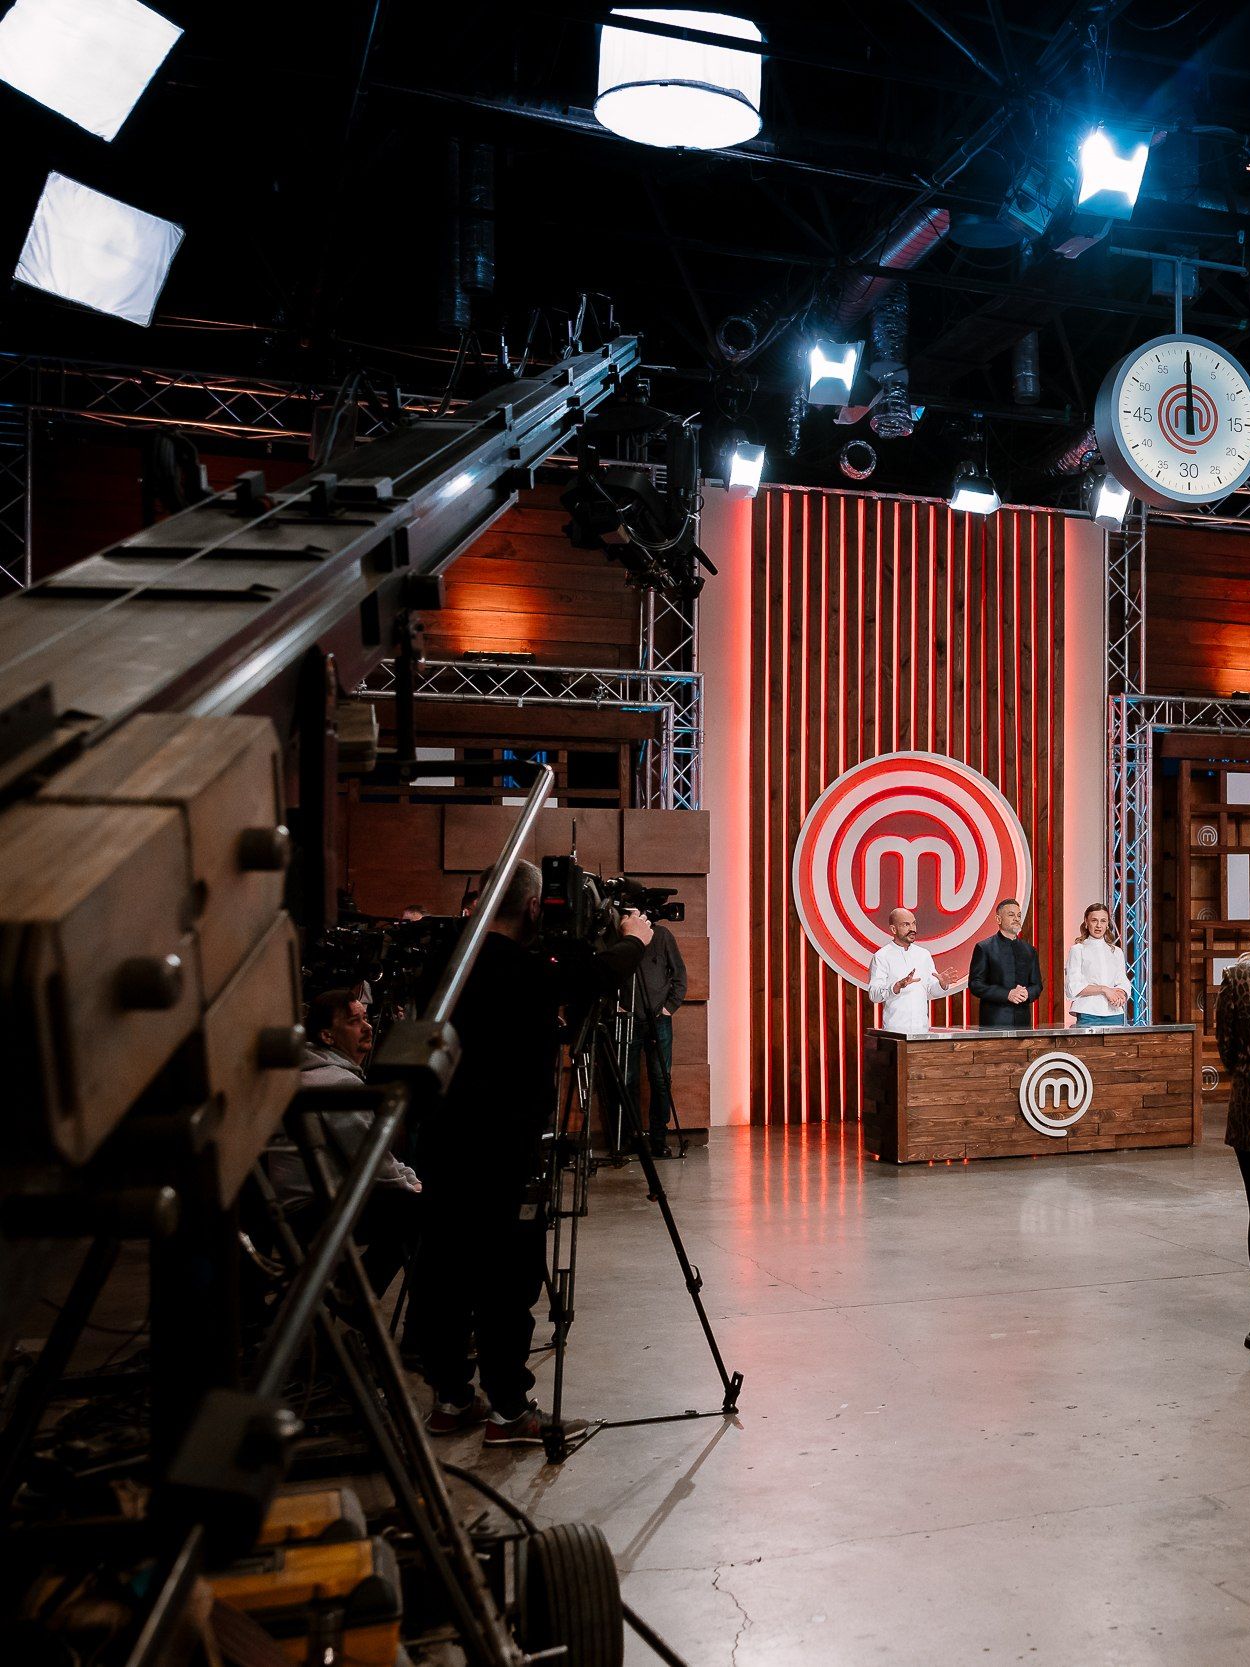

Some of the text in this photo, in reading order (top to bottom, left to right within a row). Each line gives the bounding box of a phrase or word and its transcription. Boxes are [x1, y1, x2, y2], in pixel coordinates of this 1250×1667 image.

[1157, 365, 1169, 375] 55
[1210, 371, 1217, 380] 5
[1139, 382, 1151, 392] 50
[1226, 393, 1236, 402] 10
[1132, 407, 1153, 423] 45
[1227, 419, 1243, 433] 15
[1141, 439, 1153, 448] 40
[1225, 447, 1236, 456] 20
[1157, 461, 1169, 470] 35
[1179, 462, 1199, 478] 30
[1209, 465, 1221, 475] 25
